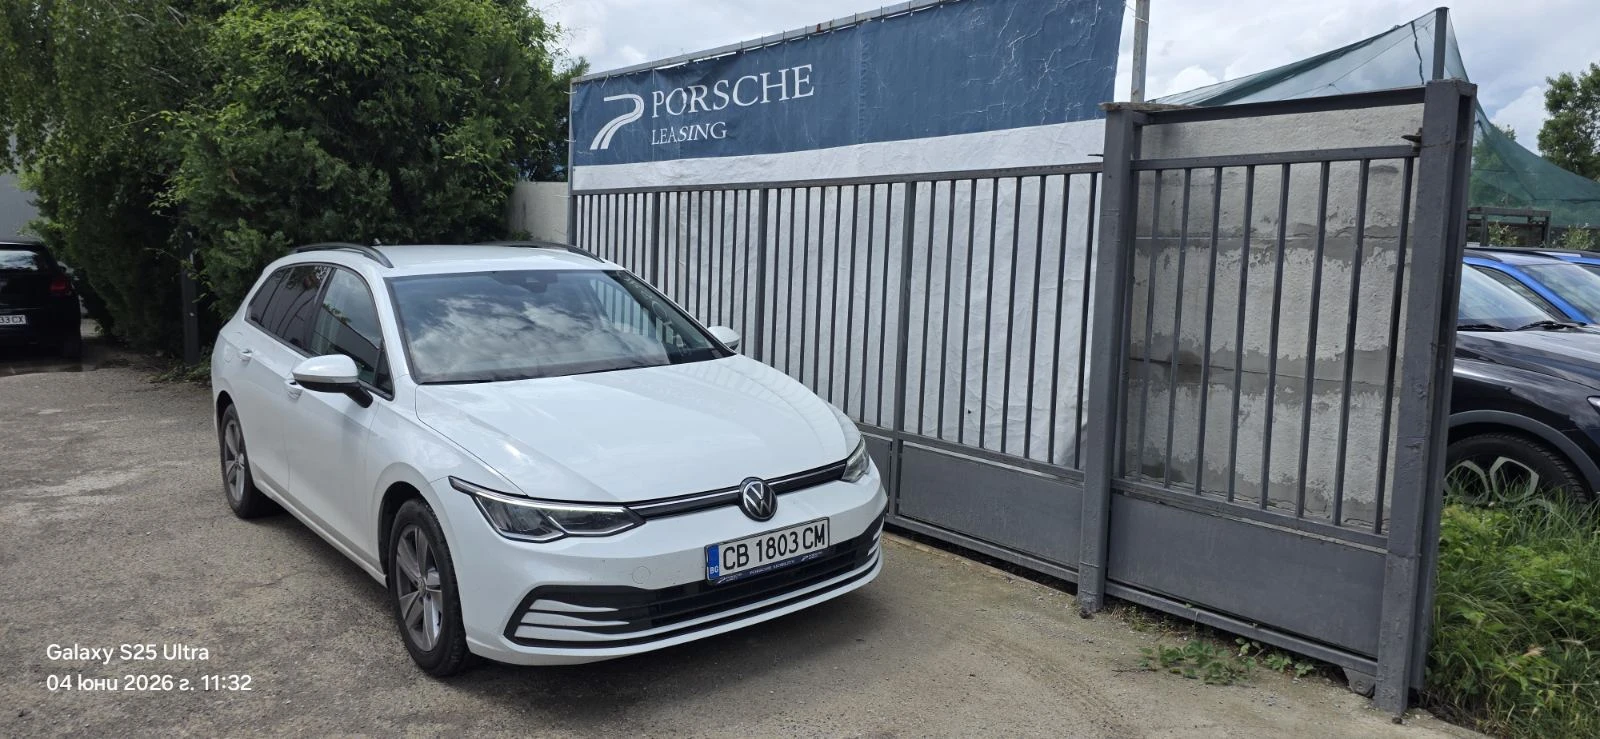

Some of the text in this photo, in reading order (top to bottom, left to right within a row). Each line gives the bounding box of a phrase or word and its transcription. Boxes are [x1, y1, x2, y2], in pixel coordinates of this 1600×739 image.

[651, 64, 815, 119] PORSCHE
[651, 122, 728, 146] LEASING
[723, 523, 826, 571] CB 1803 CM
[710, 566, 719, 574] BG
